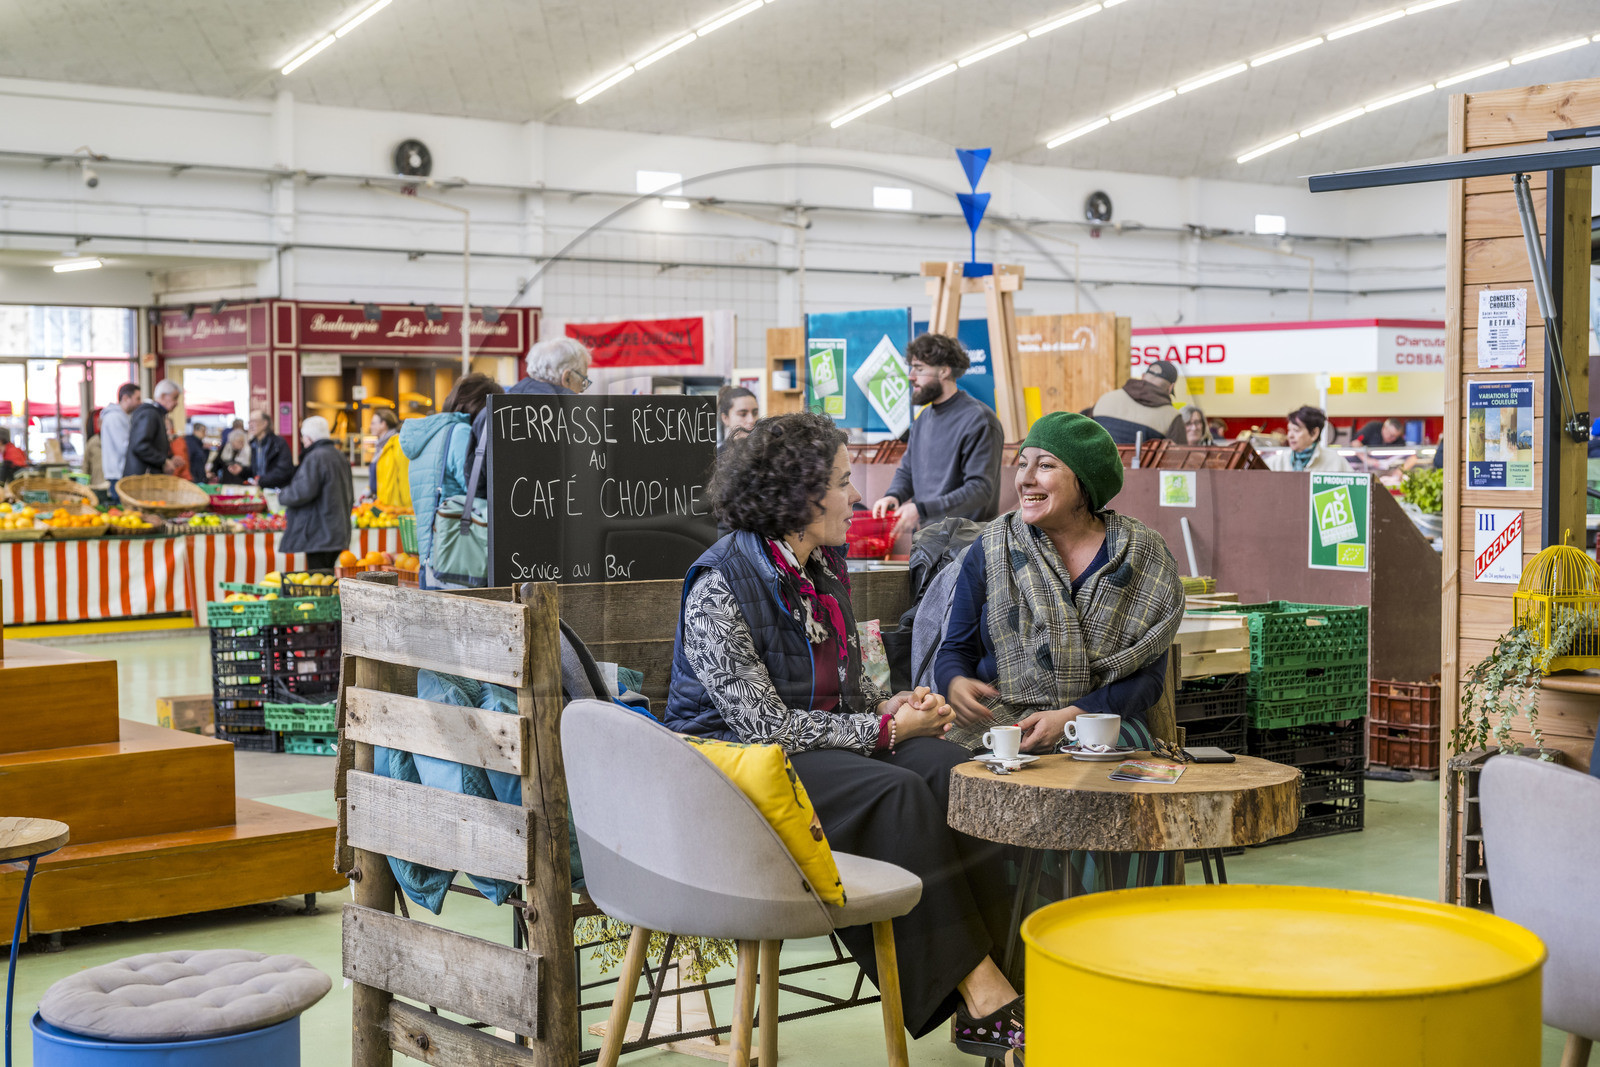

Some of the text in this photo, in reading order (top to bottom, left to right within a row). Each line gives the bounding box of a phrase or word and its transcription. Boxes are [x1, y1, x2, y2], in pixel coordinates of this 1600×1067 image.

[310, 313, 380, 340] Boulangerie
[880, 372, 907, 410] AB
[494, 402, 717, 445] TERRASSE RÉSERVÉE
[589, 450, 606, 471] AU
[1314, 476, 1368, 486] ICI PRODUITS BIO
[510, 474, 582, 519] CAFÉ
[1321, 500, 1348, 529] AB
[1479, 514, 1496, 531] III
[1476, 515, 1522, 577] LICENCE
[511, 552, 636, 580] Service au Bar
